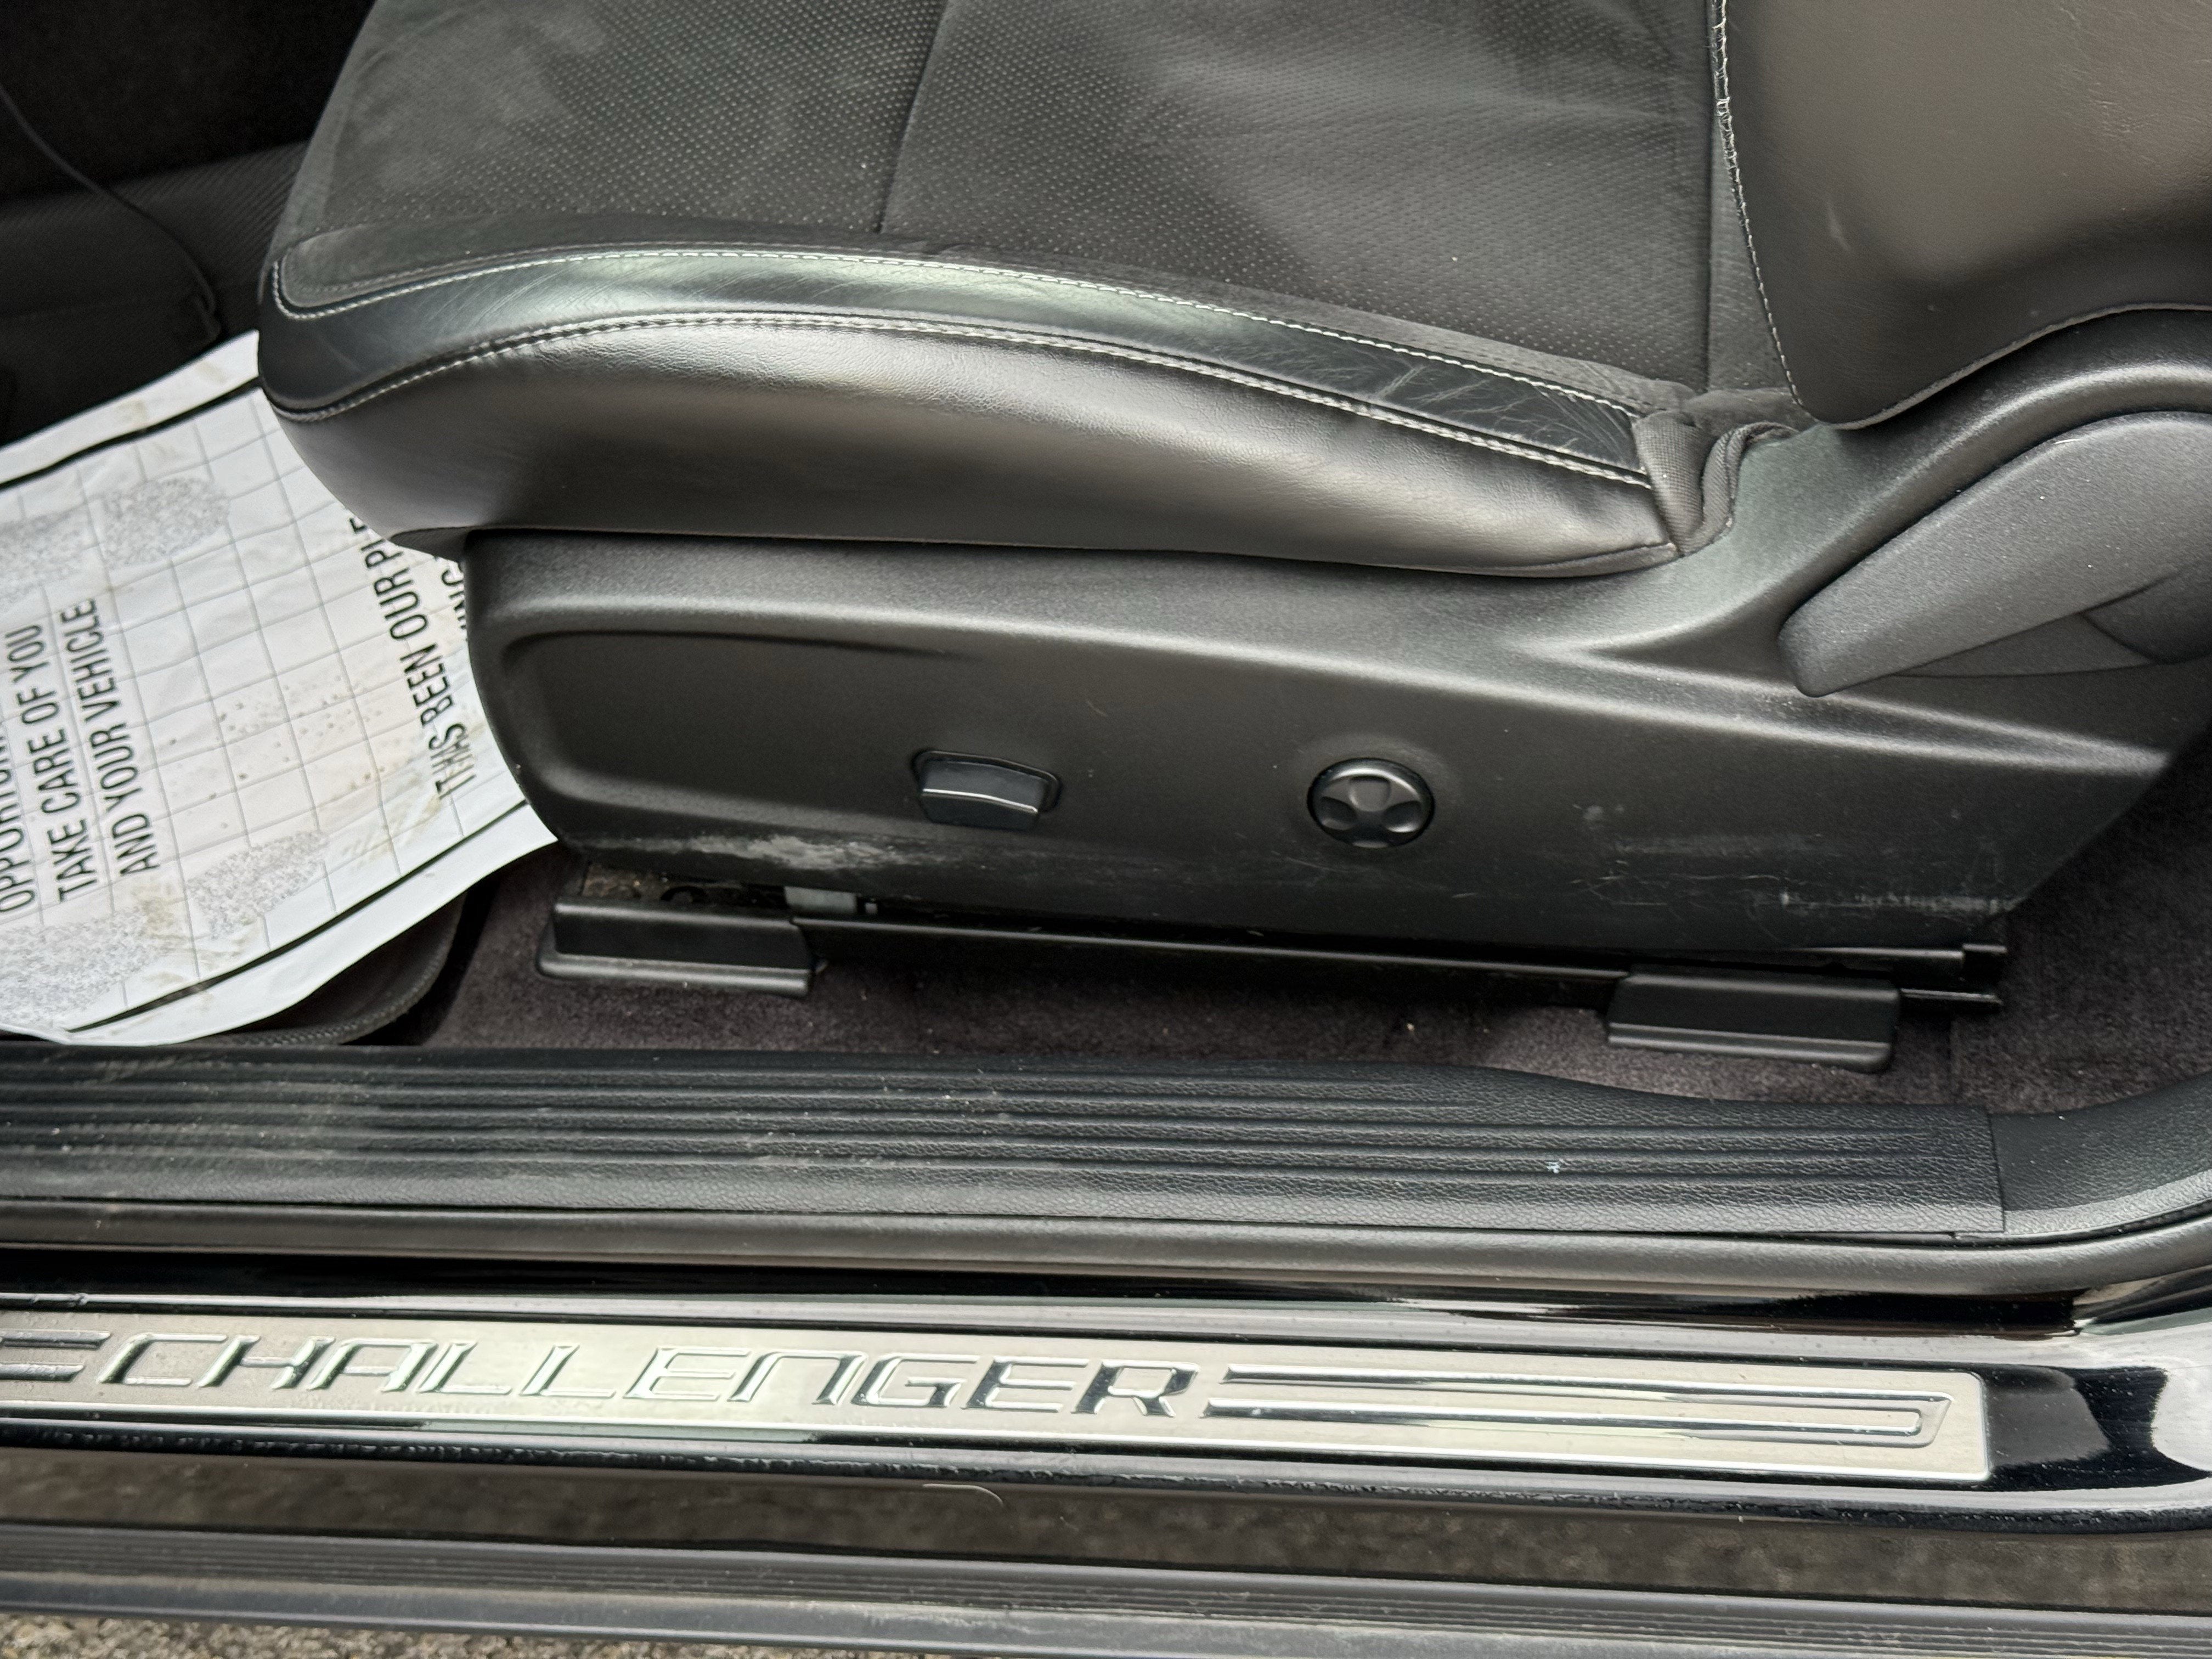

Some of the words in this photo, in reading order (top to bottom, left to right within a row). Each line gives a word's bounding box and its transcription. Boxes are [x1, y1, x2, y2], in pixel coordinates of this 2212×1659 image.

[374, 567, 427, 639] OUR
[5, 624, 49, 682] YOU
[59, 598, 121, 721] VEHICLE
[399, 642, 454, 727] BEEN
[16, 687, 59, 724] OF
[27, 728, 81, 813] CARE
[88, 722, 142, 812] YOUR
[429, 723, 473, 775] HAS
[435, 764, 477, 800] IT
[47, 819, 98, 901] TAKE
[111, 814, 160, 876] AND
[96, 1332, 1200, 1418] CHALLENGER
